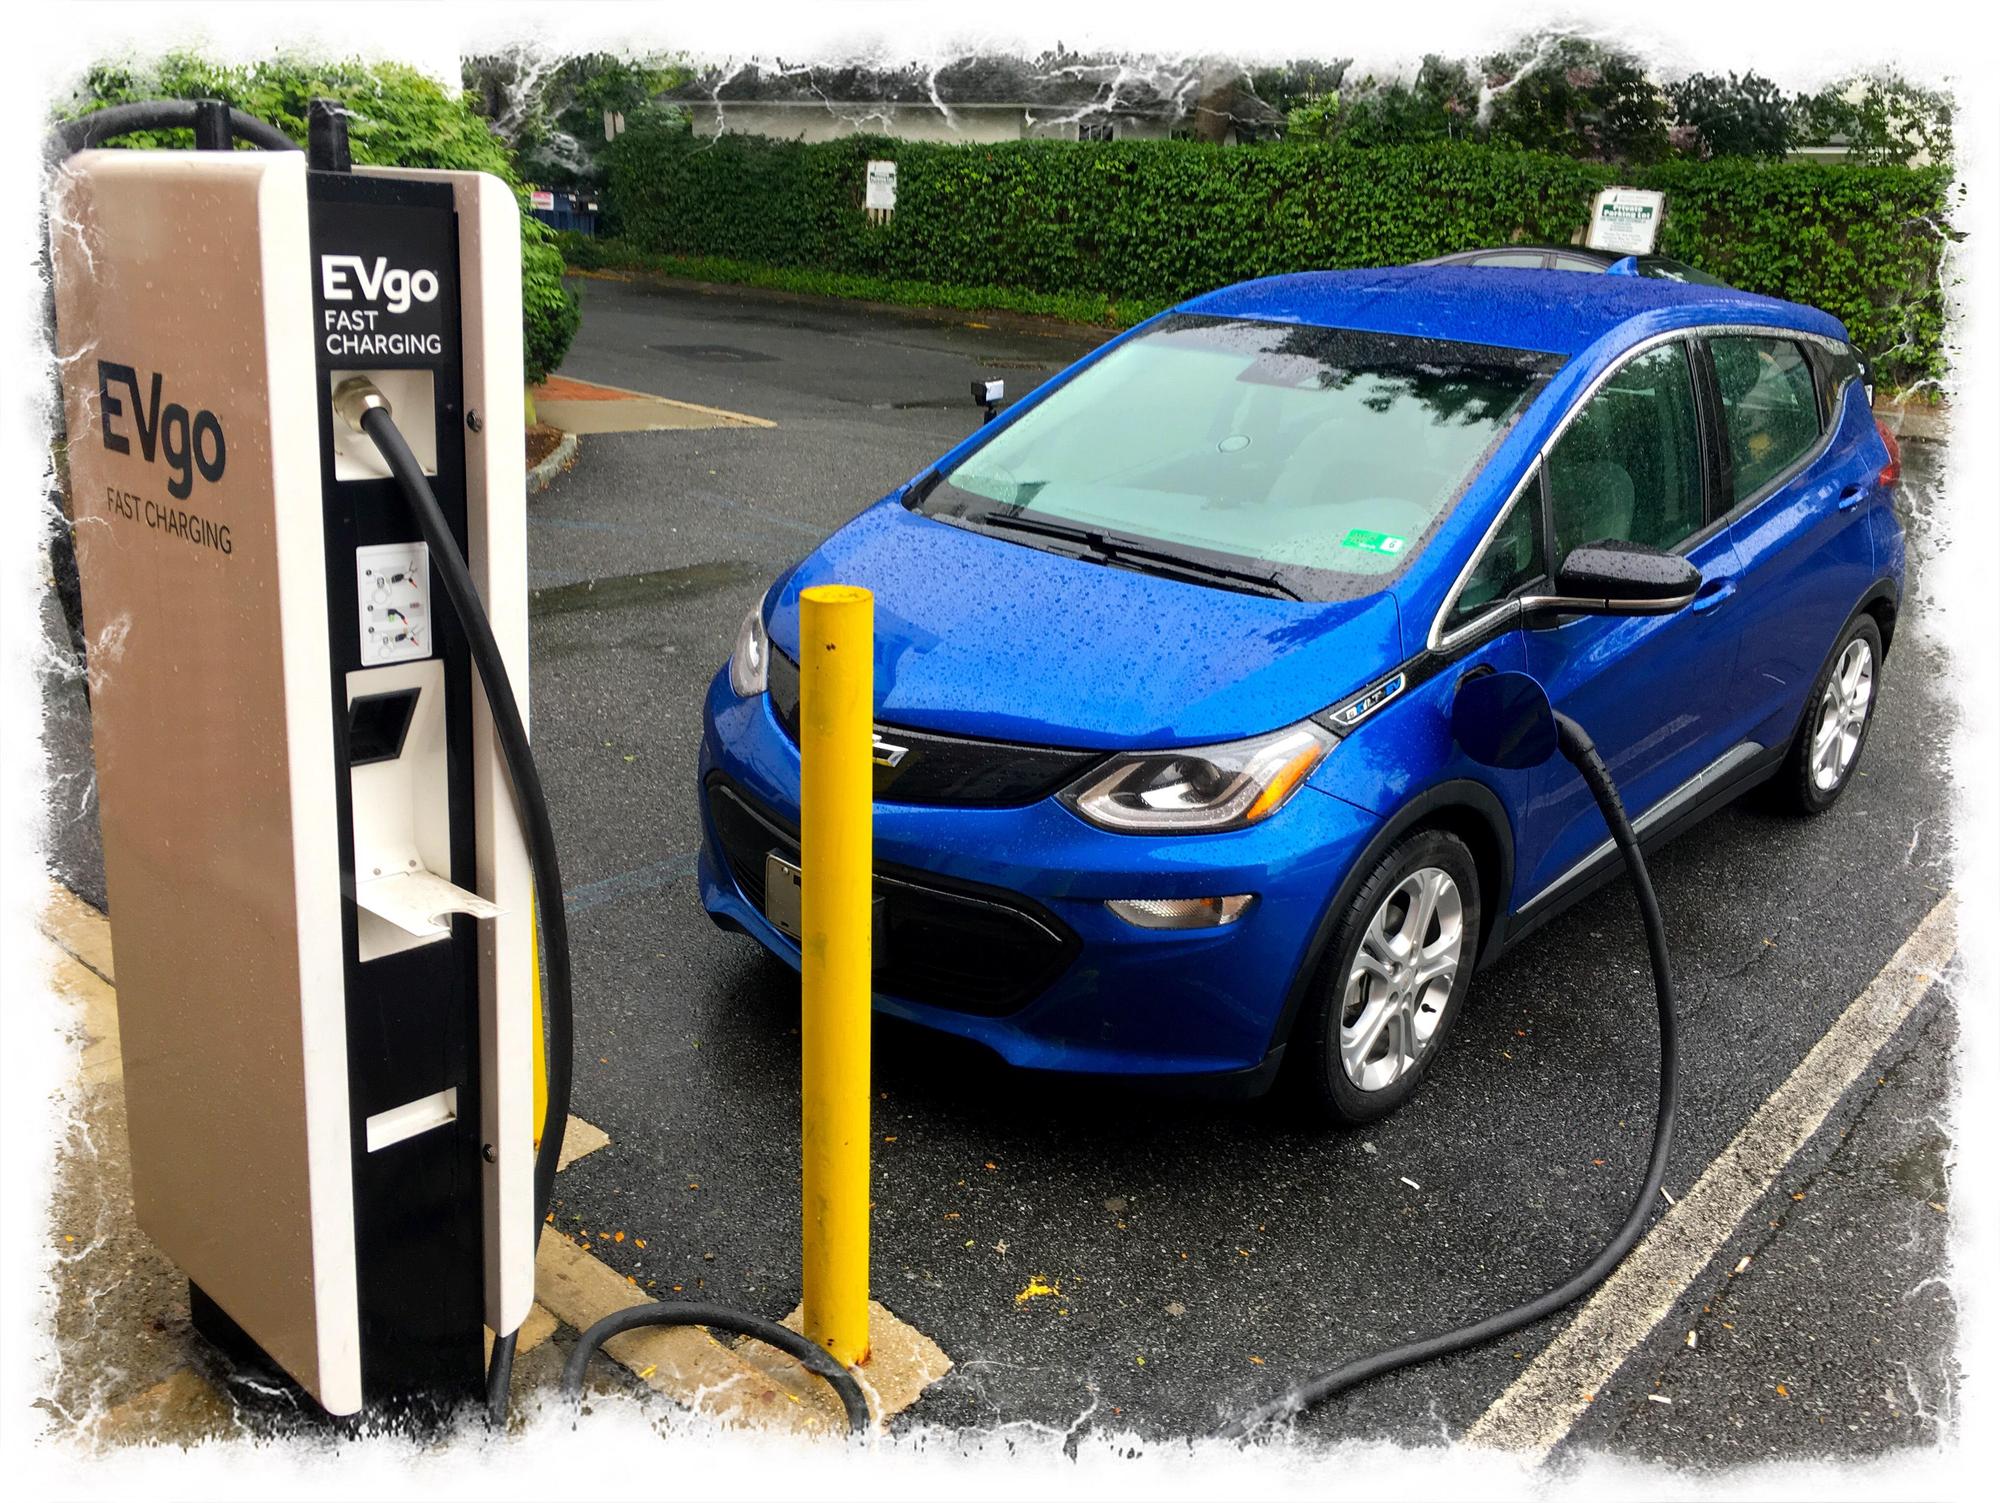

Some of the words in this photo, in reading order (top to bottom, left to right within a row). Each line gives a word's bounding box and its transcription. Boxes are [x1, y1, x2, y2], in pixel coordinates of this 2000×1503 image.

[1603, 209, 1636, 219] Parking
[321, 254, 439, 314] EVgo
[324, 309, 379, 331] FAST
[326, 333, 441, 355] CHARGING
[97, 359, 226, 500] EVgo
[106, 487, 142, 522] FAST
[144, 500, 232, 555] CHARGING
[1345, 690, 1383, 720] BOLT
[1385, 676, 1401, 696] EV
